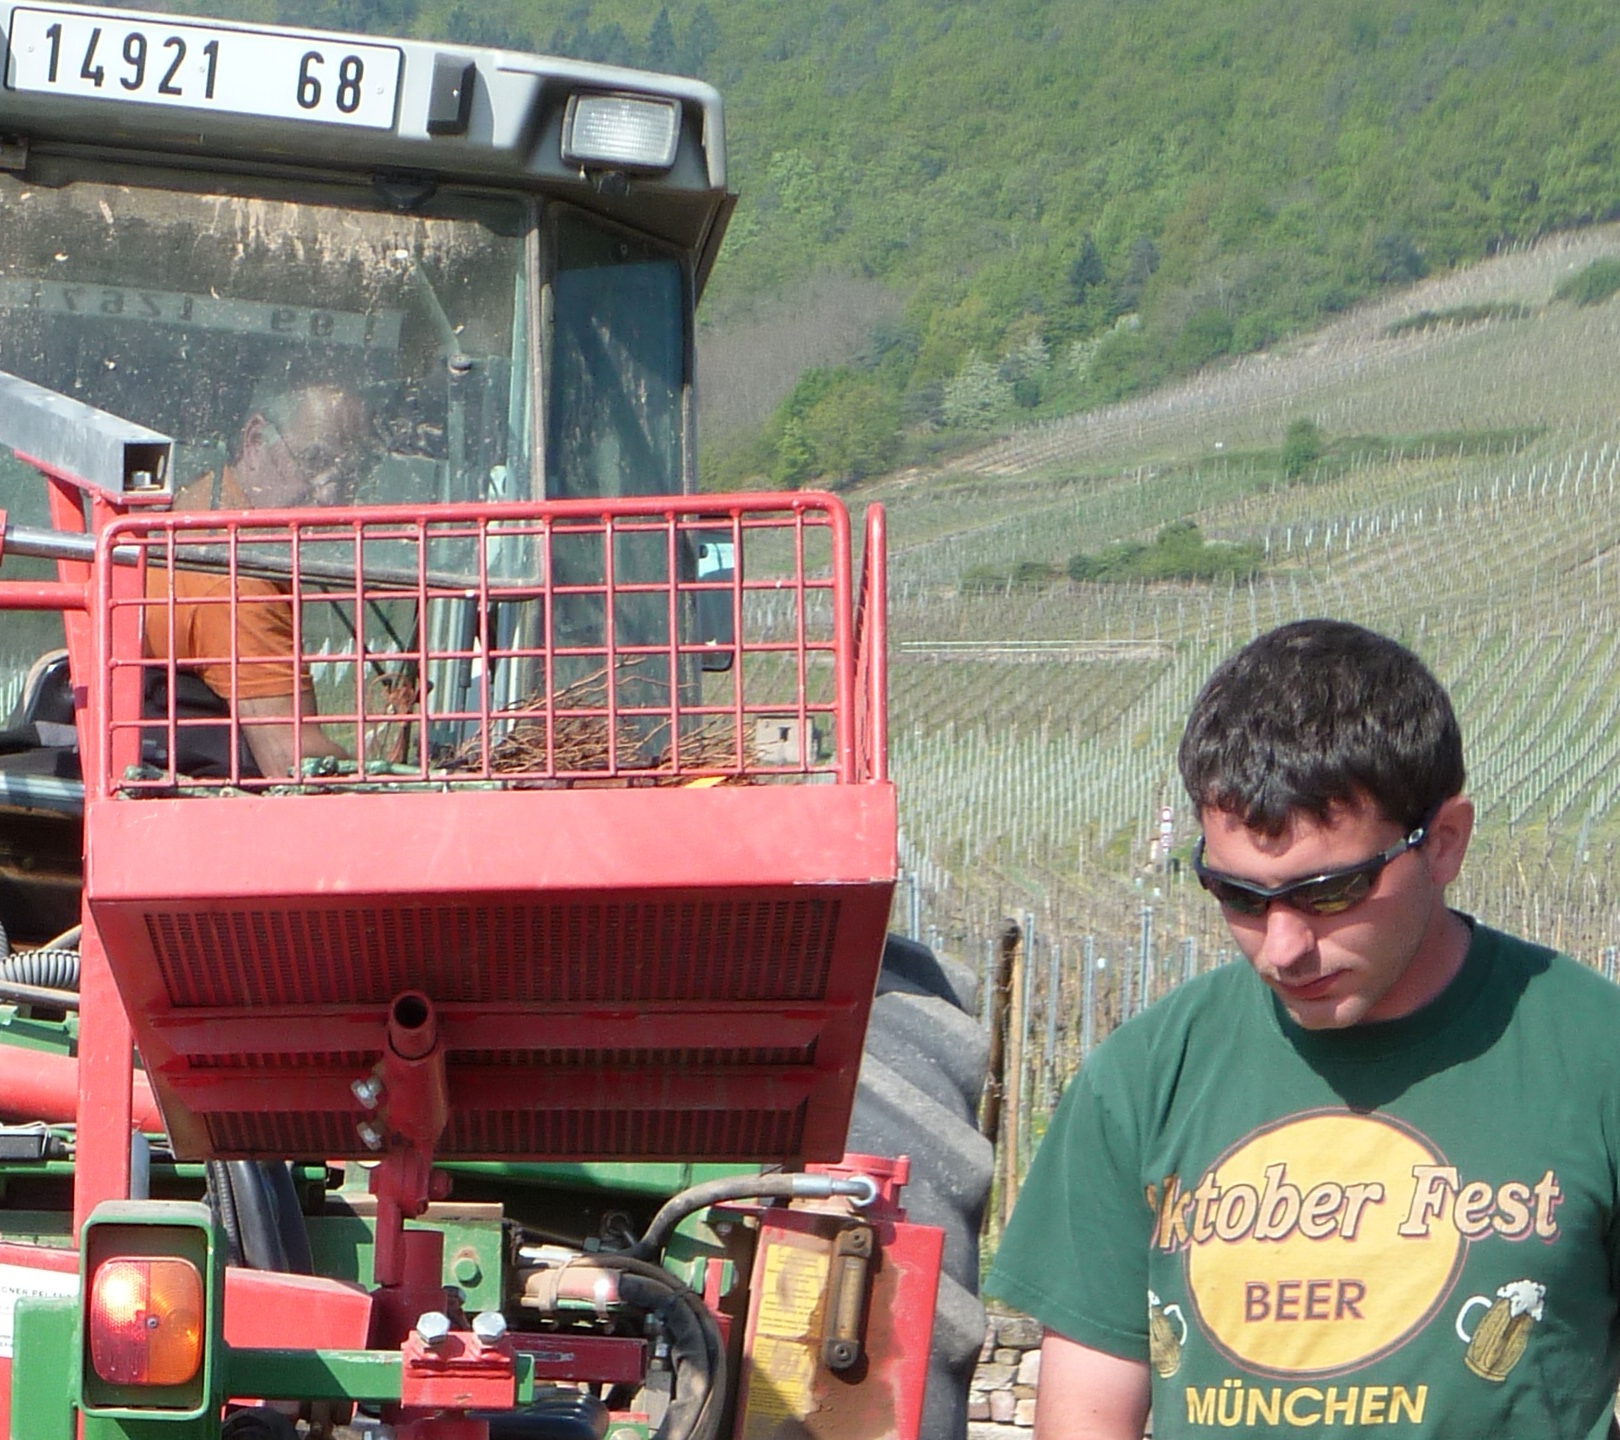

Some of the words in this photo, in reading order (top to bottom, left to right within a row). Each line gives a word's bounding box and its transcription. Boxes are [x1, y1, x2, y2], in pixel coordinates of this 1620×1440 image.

[45, 22, 219, 100] 14921
[296, 50, 365, 114] 68
[1397, 1164, 1564, 1246] Fest
[1244, 1279, 1367, 1323] BEER
[1185, 1380, 1428, 1428] MÜNCHEN
